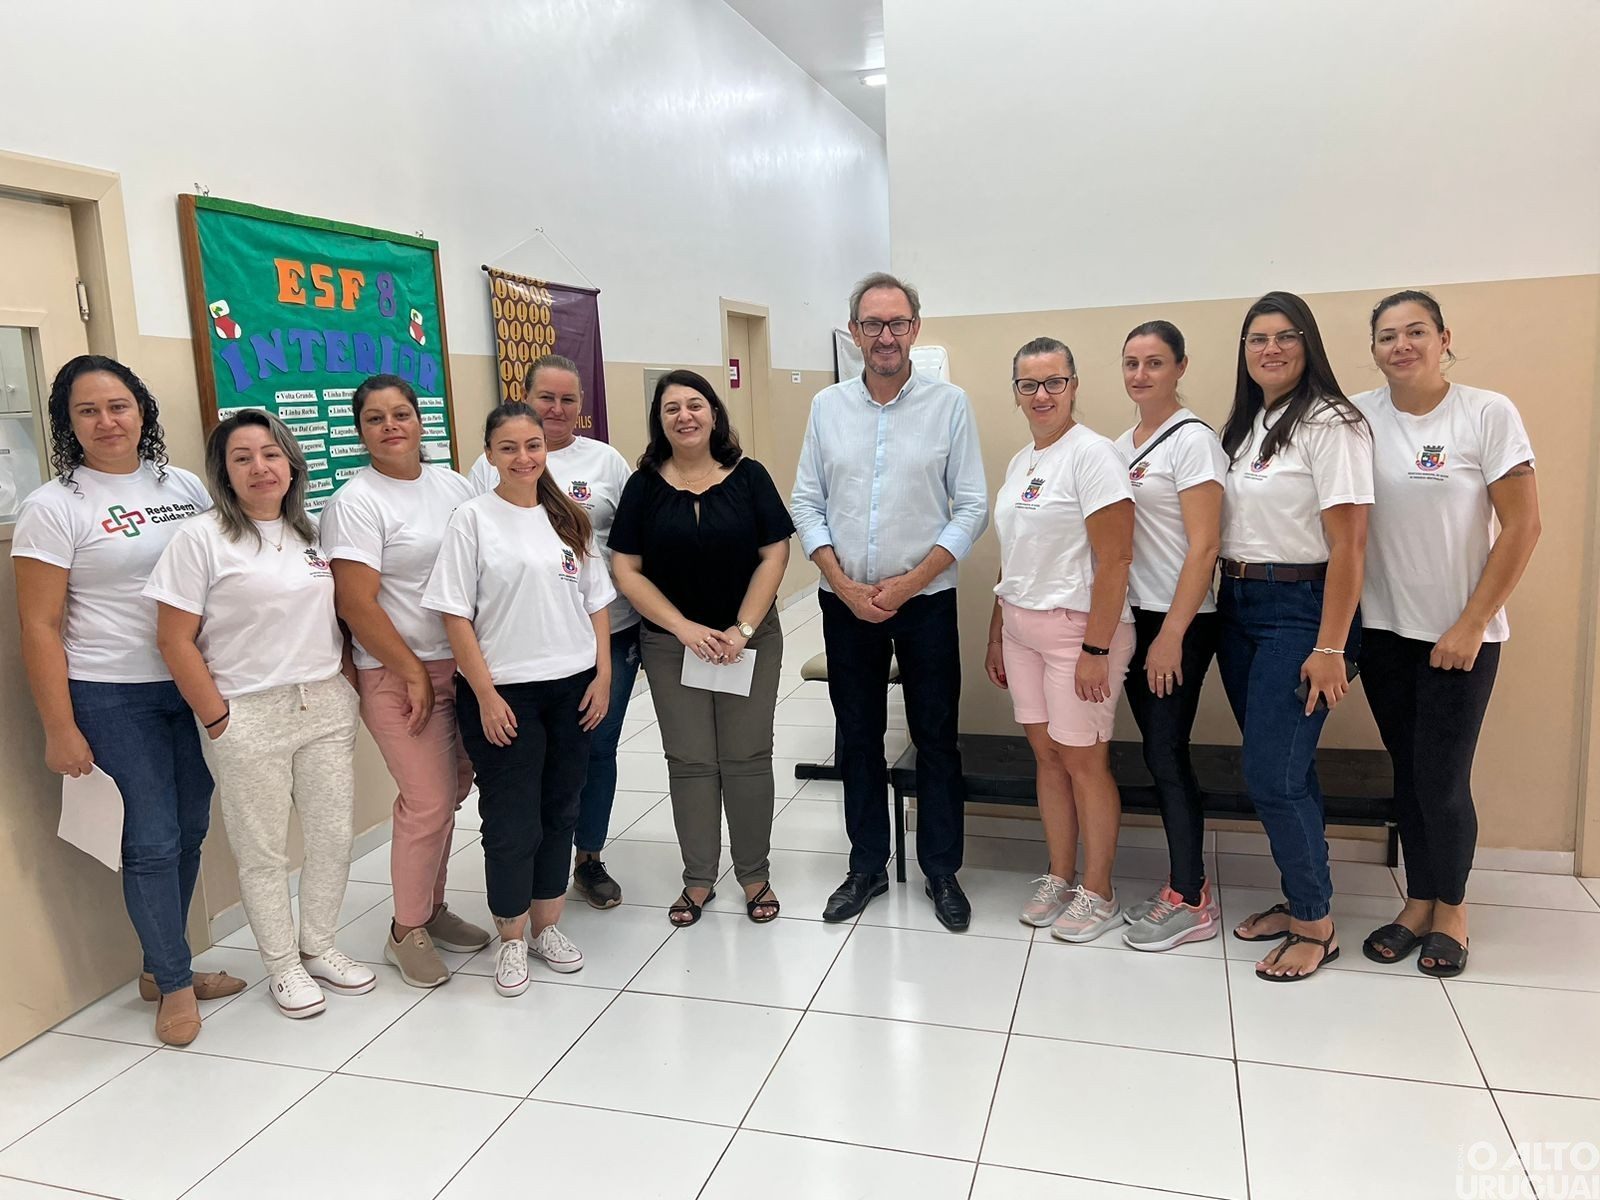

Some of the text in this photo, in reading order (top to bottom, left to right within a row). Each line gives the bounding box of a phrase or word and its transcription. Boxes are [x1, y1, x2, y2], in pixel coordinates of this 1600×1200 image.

[274, 258, 397, 318] ESF 8
[220, 328, 439, 395] INTERIOR
[144, 503, 195, 516] Rede Bem
[151, 512, 186, 524] Cuidar
